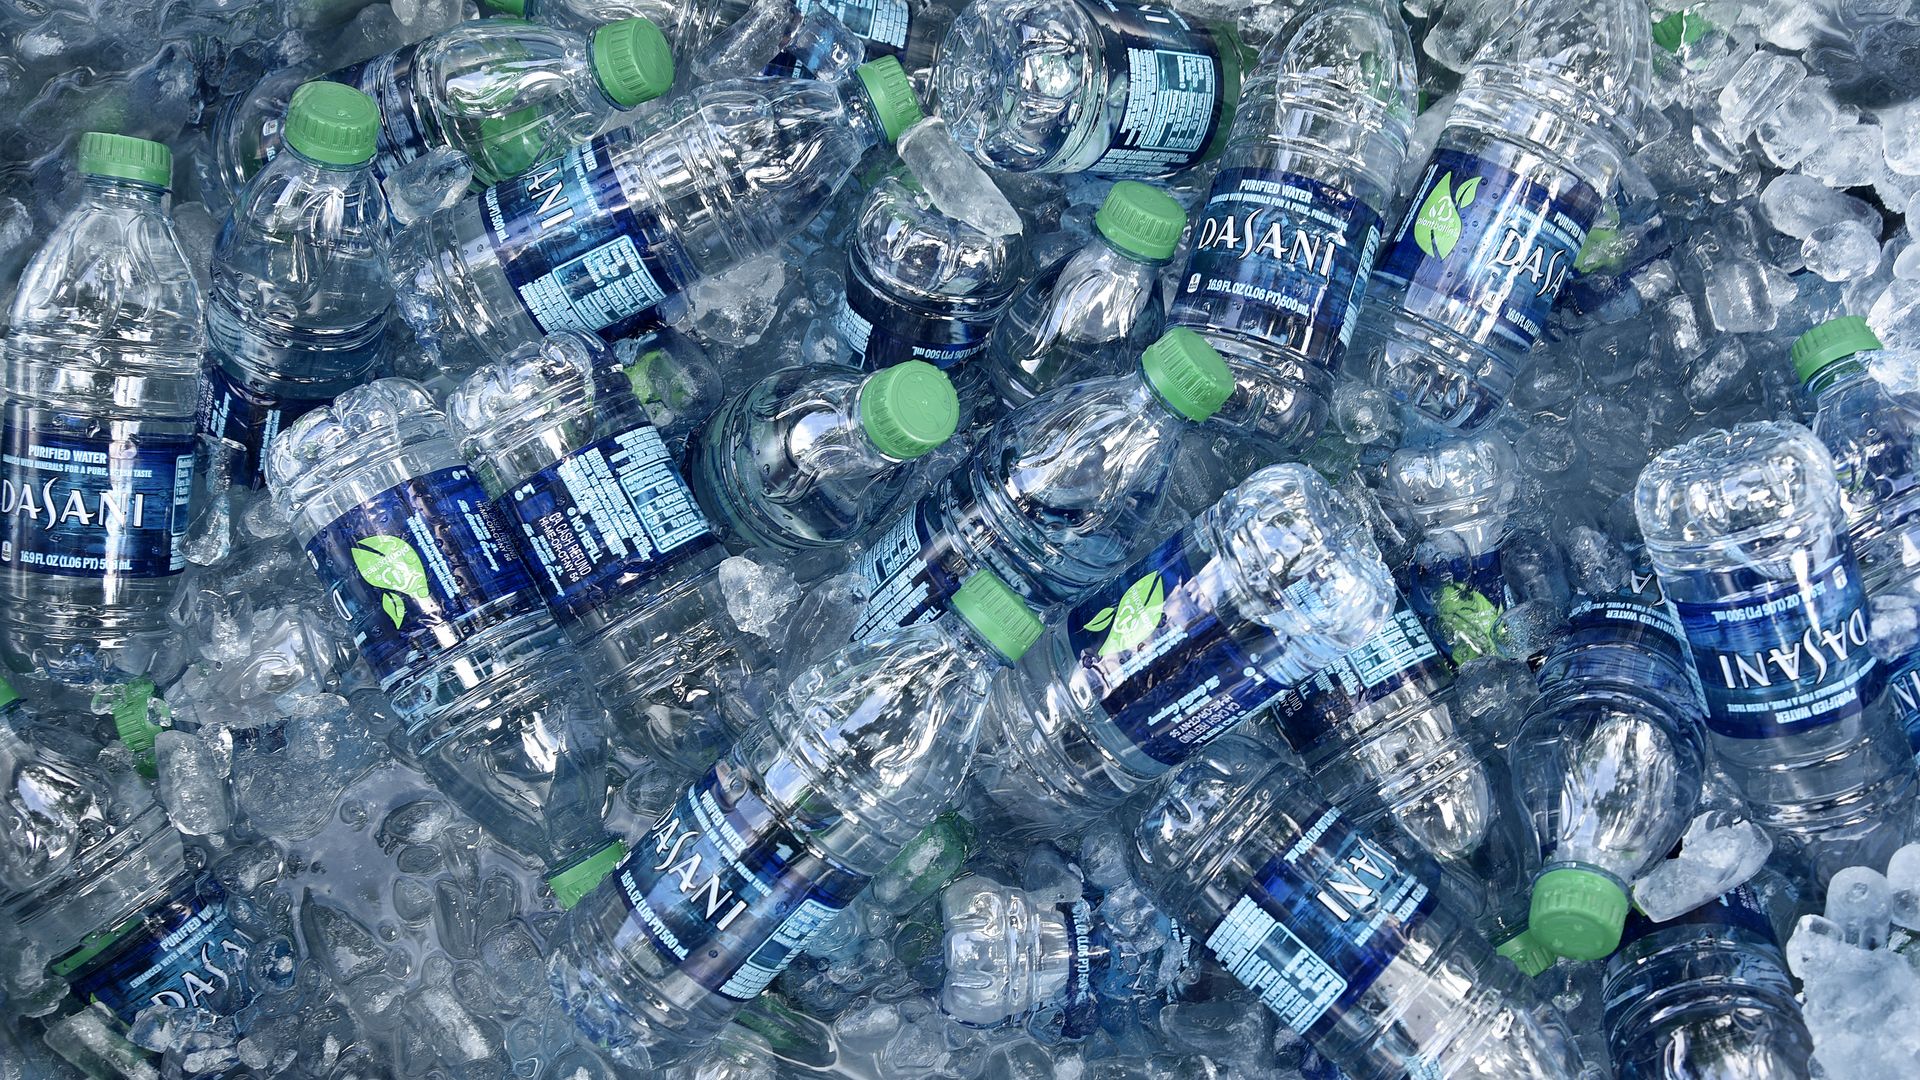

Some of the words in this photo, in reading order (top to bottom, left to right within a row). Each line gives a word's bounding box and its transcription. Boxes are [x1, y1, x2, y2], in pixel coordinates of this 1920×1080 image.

[525, 166, 574, 230] ANI
[1240, 179, 1280, 194] PURIFIED
[1281, 185, 1313, 203] WATER
[1271, 197, 1285, 208] FOR
[1291, 202, 1311, 216] PURE,
[1311, 208, 1332, 223] FRESH
[490, 214, 504, 231] 500
[495, 228, 508, 244] mL
[1197, 208, 1336, 277] DASANI
[1495, 228, 1567, 297] DASA
[1222, 281, 1232, 293] FL
[1232, 283, 1244, 295] OZ
[1244, 285, 1266, 301] (1.06
[1266, 289, 1282, 305] PT)
[1280, 294, 1299, 312] 500
[1297, 301, 1311, 317] mL
[911, 345, 924, 354] mL
[925, 349, 940, 357] 500
[941, 350, 954, 359] PT)
[28, 445, 71, 461] PURIFIED
[73, 450, 107, 464] WATER
[64, 464, 79, 474] FOR
[80, 466, 86, 474] A
[87, 467, 108, 477] PURE,
[133, 470, 152, 478] TASTE
[1, 477, 144, 530] DASANI
[593, 484, 615, 515] COCA-COLA
[548, 511, 564, 527] CA
[554, 522, 575, 547] CASH
[570, 515, 586, 533] NO
[578, 530, 604, 565] REFILL
[538, 516, 575, 572] HI-ME-OR-CT-NY
[568, 571, 580, 583] 5¢
[35, 553, 45, 565] FL
[46, 555, 59, 566] OZ
[60, 555, 82, 569] (1.06
[83, 557, 98, 570] PT)
[119, 560, 132, 570] mL
[566, 543, 592, 577] REFUND
[1632, 603, 1645, 612] FOR
[1761, 597, 1785, 615] (1.06
[1784, 592, 1798, 607] OZ
[1605, 609, 1636, 621] WATER
[1710, 610, 1725, 622] mL
[1725, 608, 1745, 621] 500
[1745, 604, 1762, 619] PT)
[1719, 609, 1868, 688] DASANI
[1224, 699, 1240, 714] CA
[1791, 696, 1798, 705] A
[1811, 687, 1856, 714] PURIFIED
[1205, 708, 1228, 727] CASH
[1774, 705, 1812, 723] WATER
[1177, 720, 1208, 745] REFUND
[699, 789, 725, 827] PURIFIED
[717, 821, 747, 854] WATER
[1293, 835, 1312, 855] 500
[651, 803, 748, 931] DASANI
[733, 860, 755, 882] FRESH
[626, 883, 636, 895] FL
[629, 890, 642, 904] OZ
[634, 899, 655, 922] (1.06
[159, 914, 202, 952] PURIFIED
[646, 916, 666, 935] PT)
[658, 929, 679, 949] 500
[1076, 935, 1089, 956] (1.06
[672, 944, 688, 960] mL
[129, 962, 162, 989] ENHANCED
[159, 950, 179, 967] WITH
[151, 937, 250, 1010] DASA
[1076, 957, 1089, 972] PT)
